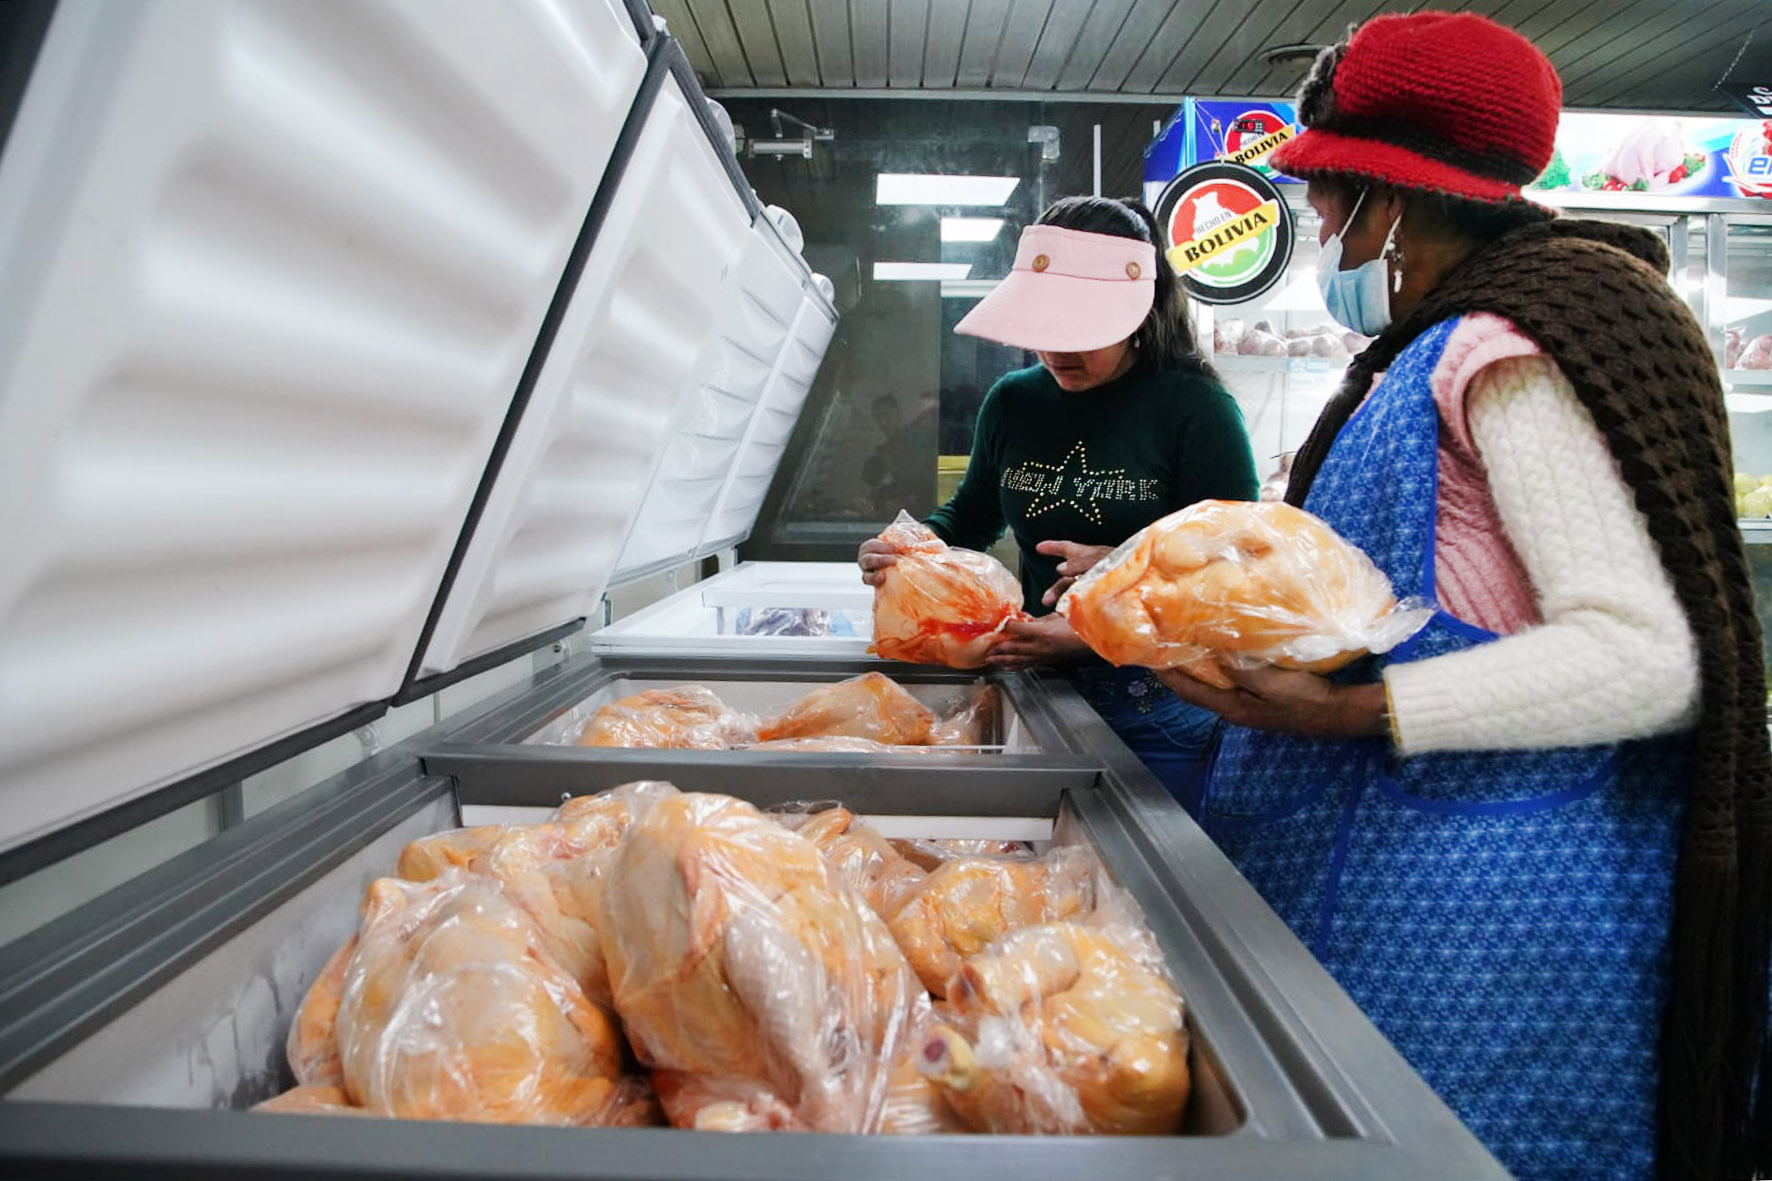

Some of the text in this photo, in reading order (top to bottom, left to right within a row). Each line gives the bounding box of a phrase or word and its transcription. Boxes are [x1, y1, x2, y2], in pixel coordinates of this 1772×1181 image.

[1235, 133, 1288, 163] BOLIVIA
[1185, 212, 1267, 262] BOLIVIA
[1196, 211, 1232, 233] HECHO EN
